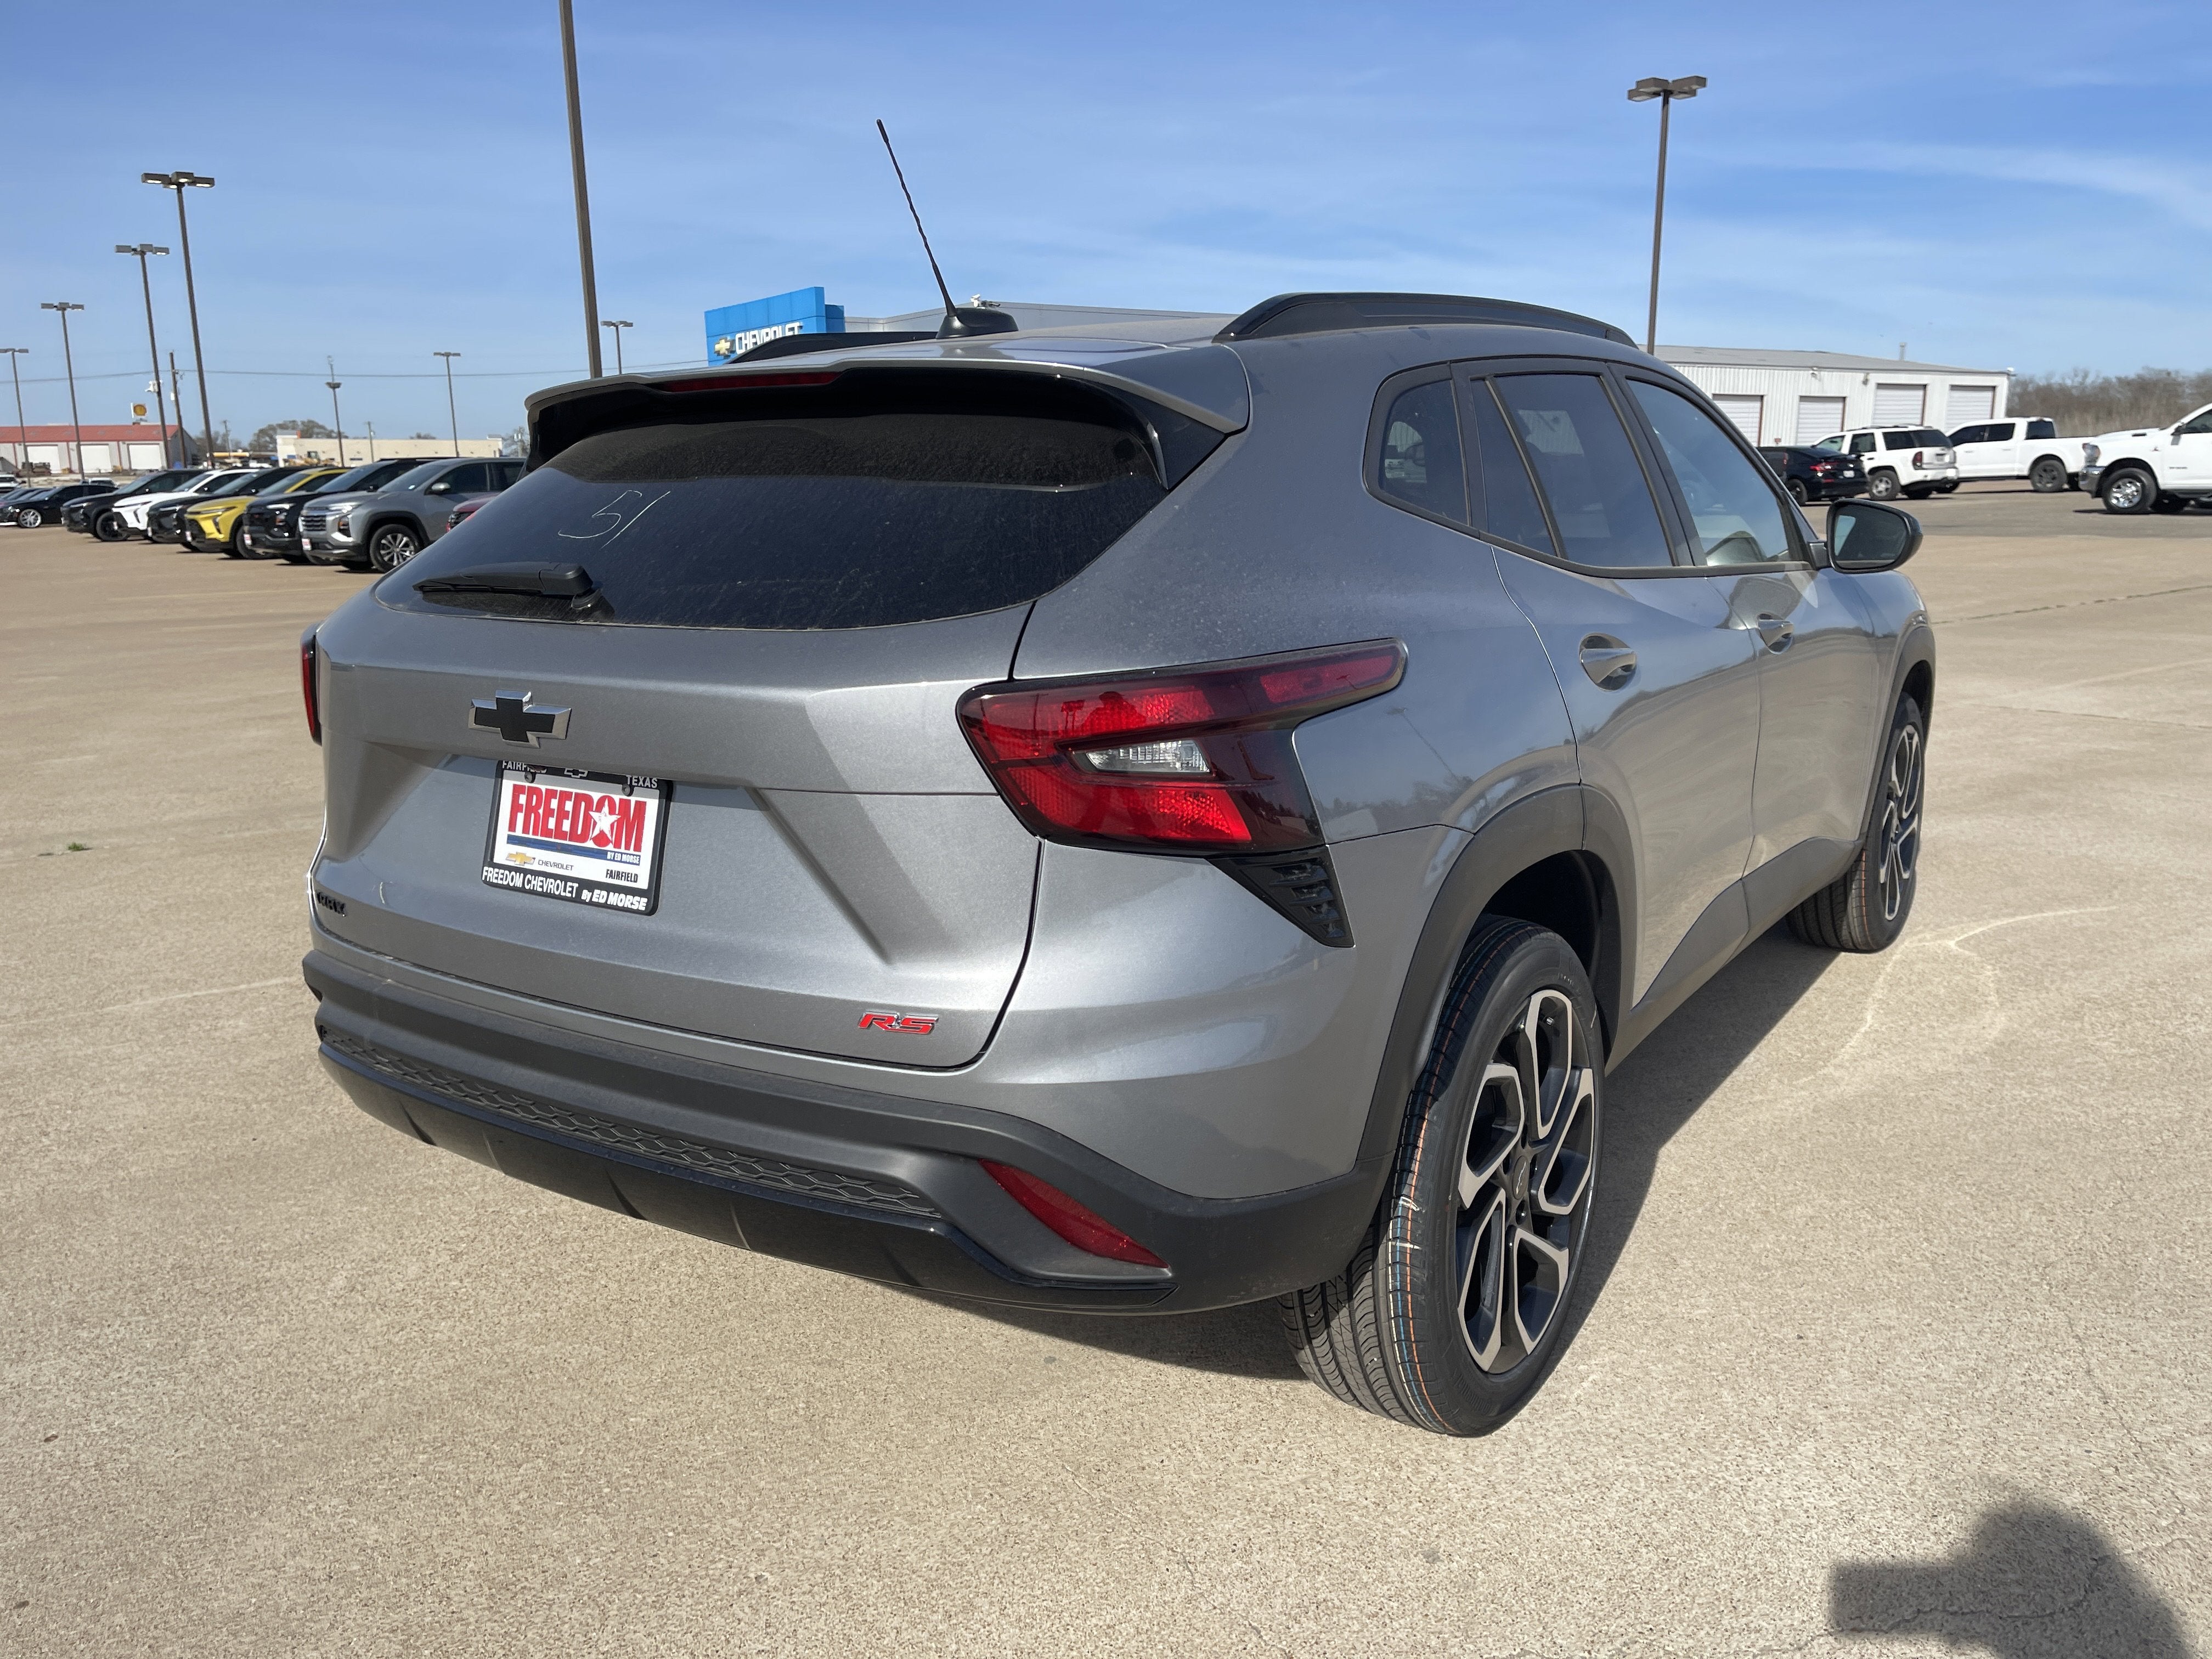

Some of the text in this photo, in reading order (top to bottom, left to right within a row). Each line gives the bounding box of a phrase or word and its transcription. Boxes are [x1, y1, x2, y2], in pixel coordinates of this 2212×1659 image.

[735, 322, 800, 354] CHEVROLET
[626, 775, 658, 788] TEXAS
[508, 784, 647, 853] FREEDOM
[538, 859, 574, 871] CHEVROLET
[606, 851, 640, 865] BY ED MORSE
[605, 868, 638, 883] FAIRFIELD
[482, 866, 524, 888] FREEDOM
[524, 874, 579, 898] CHEVROLET
[591, 889, 607, 903] ED
[607, 891, 648, 911] MORSE
[857, 1009, 939, 1036] RS
